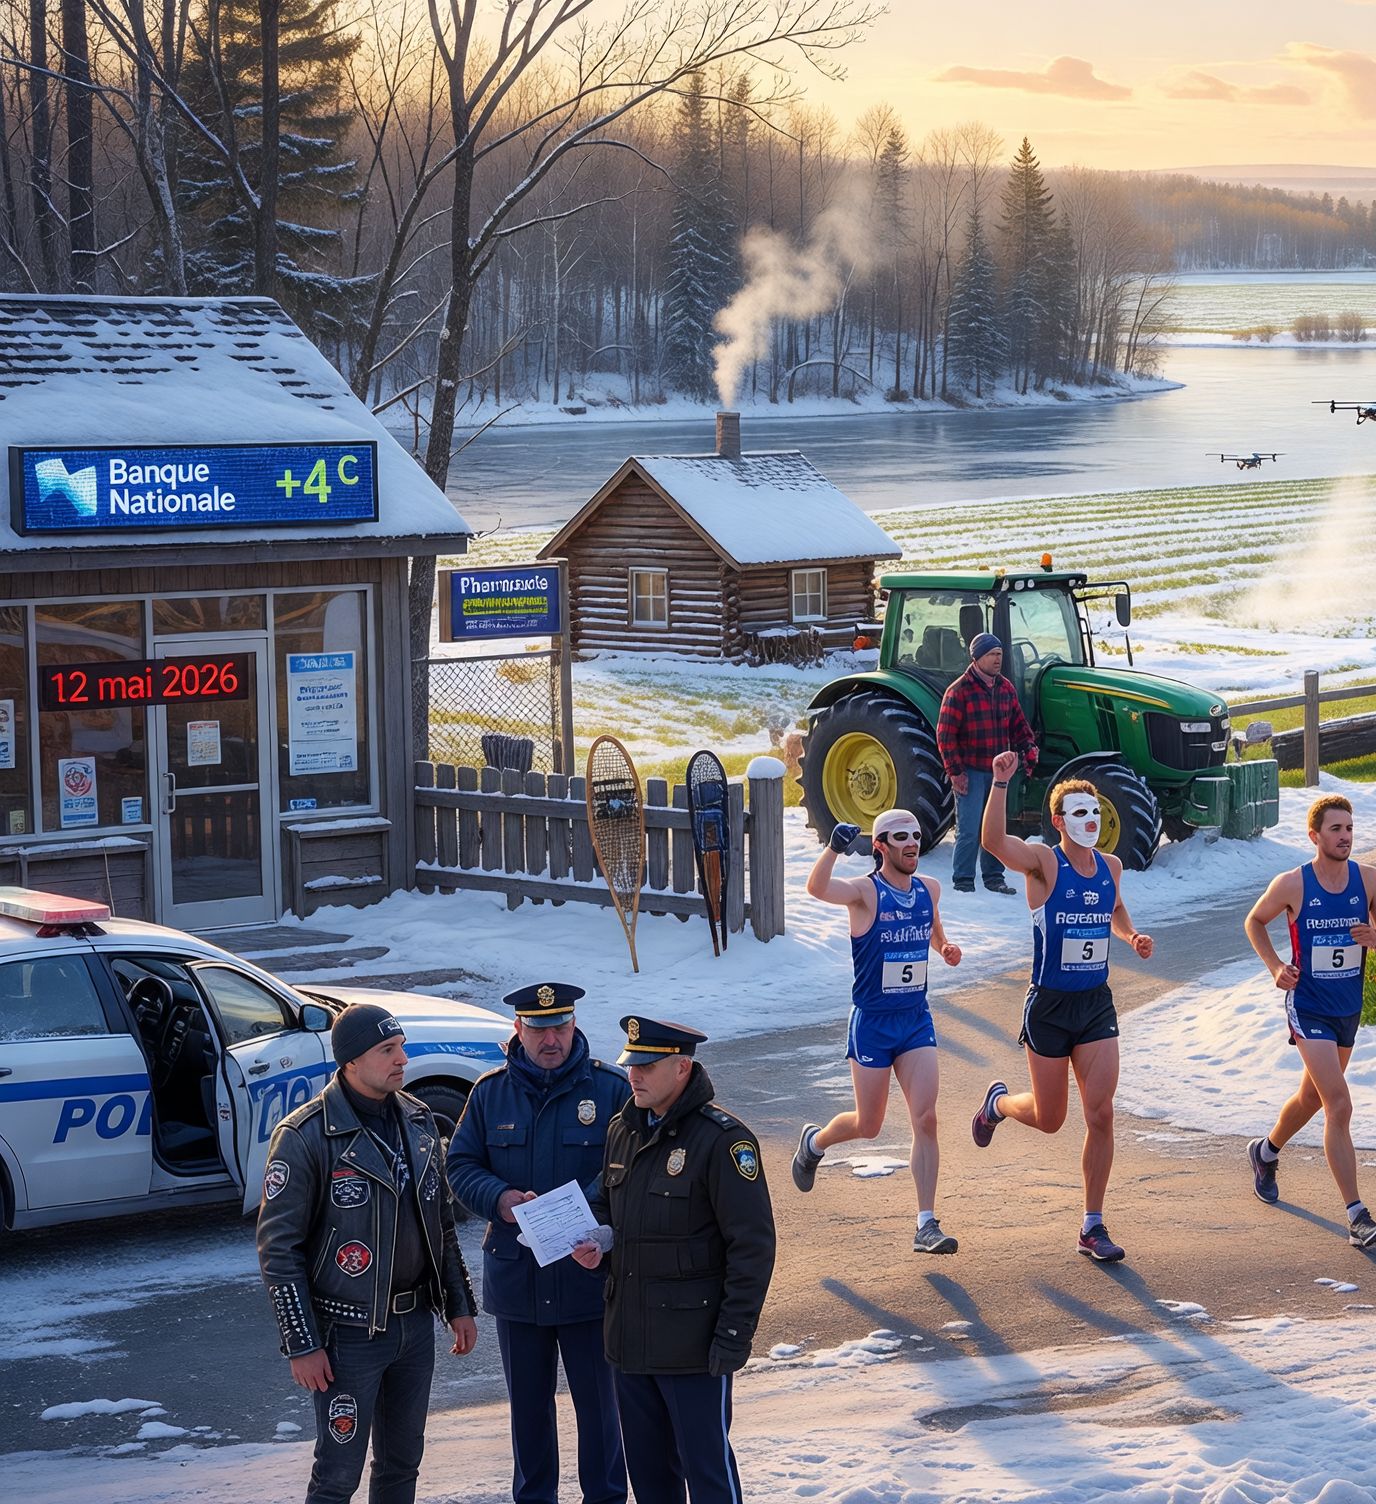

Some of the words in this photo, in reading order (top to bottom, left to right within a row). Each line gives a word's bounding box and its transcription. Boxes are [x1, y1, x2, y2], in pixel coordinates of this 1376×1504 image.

[109, 458, 210, 490] Banque
[109, 485, 236, 515] Nationale
[51, 670, 89, 703] 12
[98, 667, 152, 701] mai
[162, 661, 239, 697] 2026
[1082, 941, 1094, 961] 5
[1332, 948, 1345, 969] 5
[901, 964, 914, 984] 5
